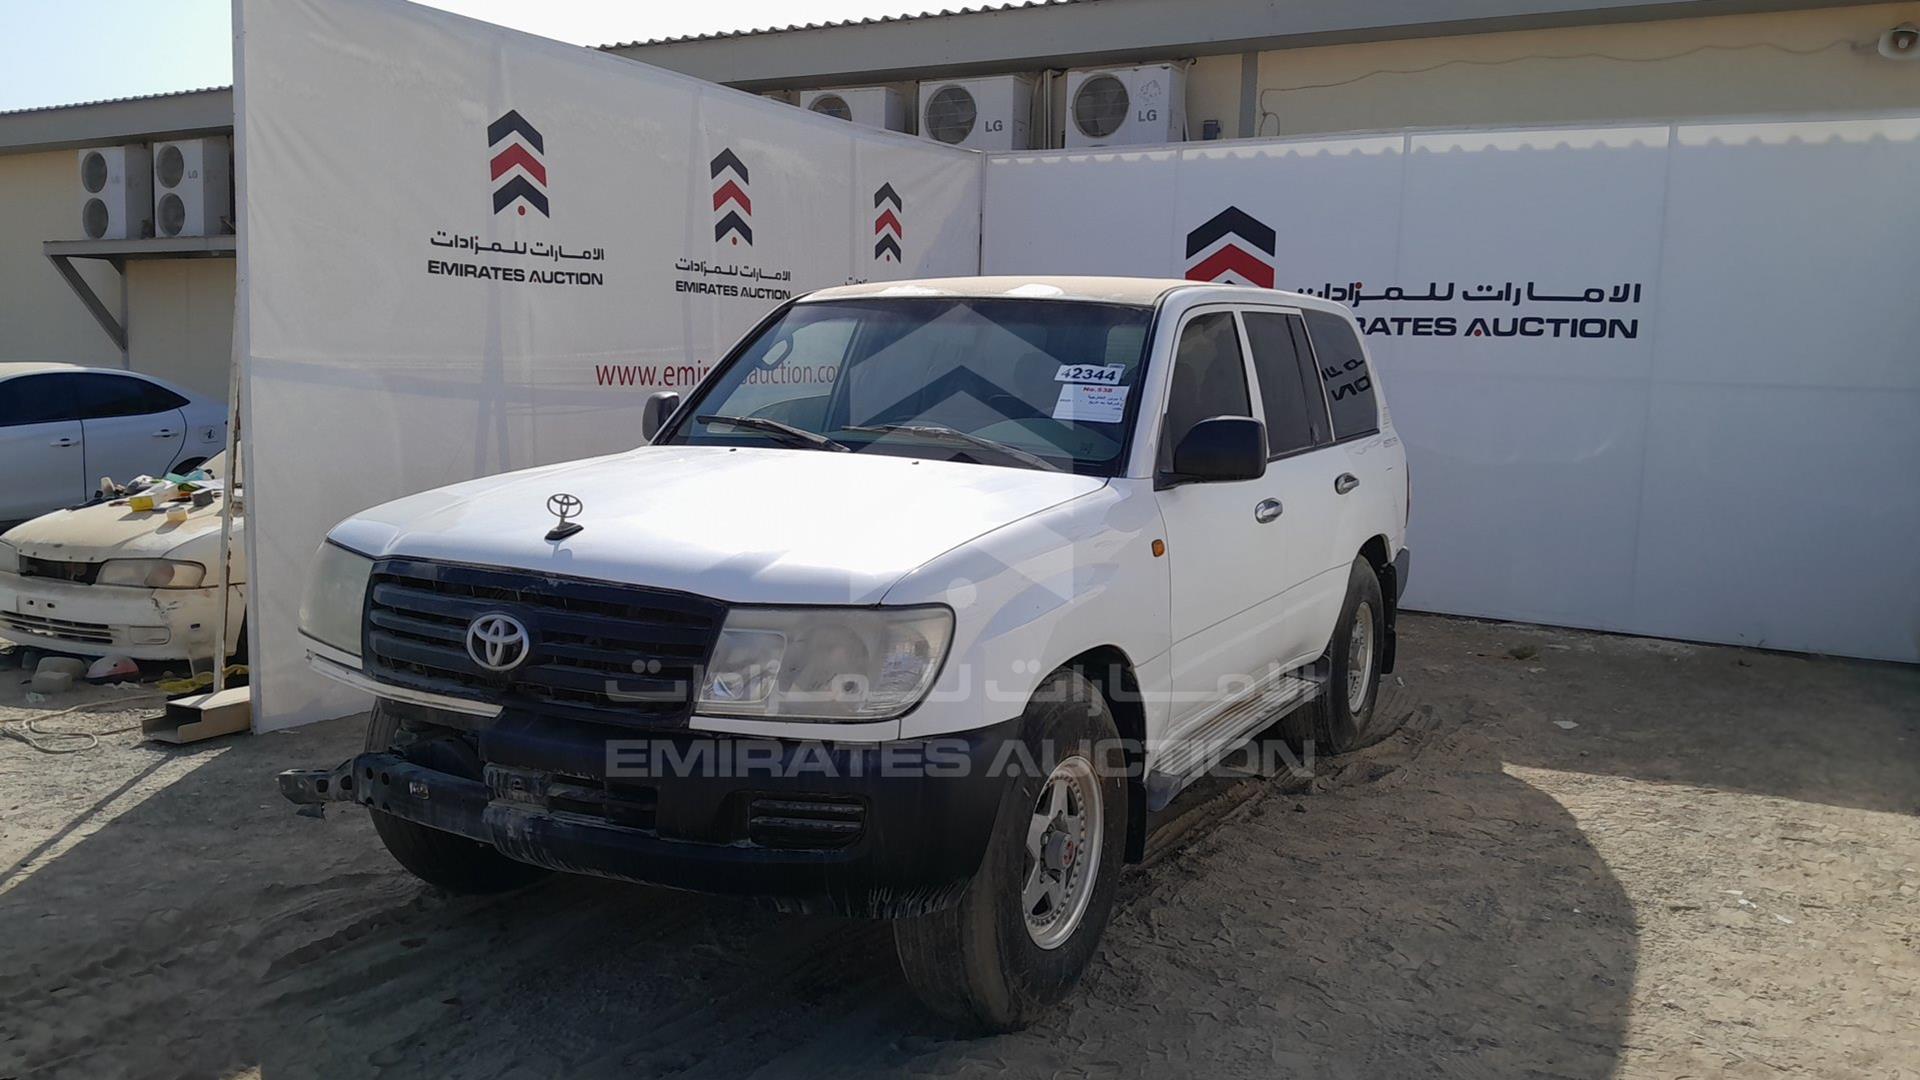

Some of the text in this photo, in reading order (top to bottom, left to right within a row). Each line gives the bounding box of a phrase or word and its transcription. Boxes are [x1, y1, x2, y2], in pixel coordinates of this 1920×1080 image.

[985, 119, 1003, 132] LG
[1138, 109, 1157, 122] LG
[430, 230, 527, 255] للمزادات
[427, 260, 603, 286] EMIRATES AUCTION
[675, 280, 791, 300] EMIRATES AUCTION
[1463, 317, 1638, 339] AUCTION
[1061, 367, 1117, 381] 42344
